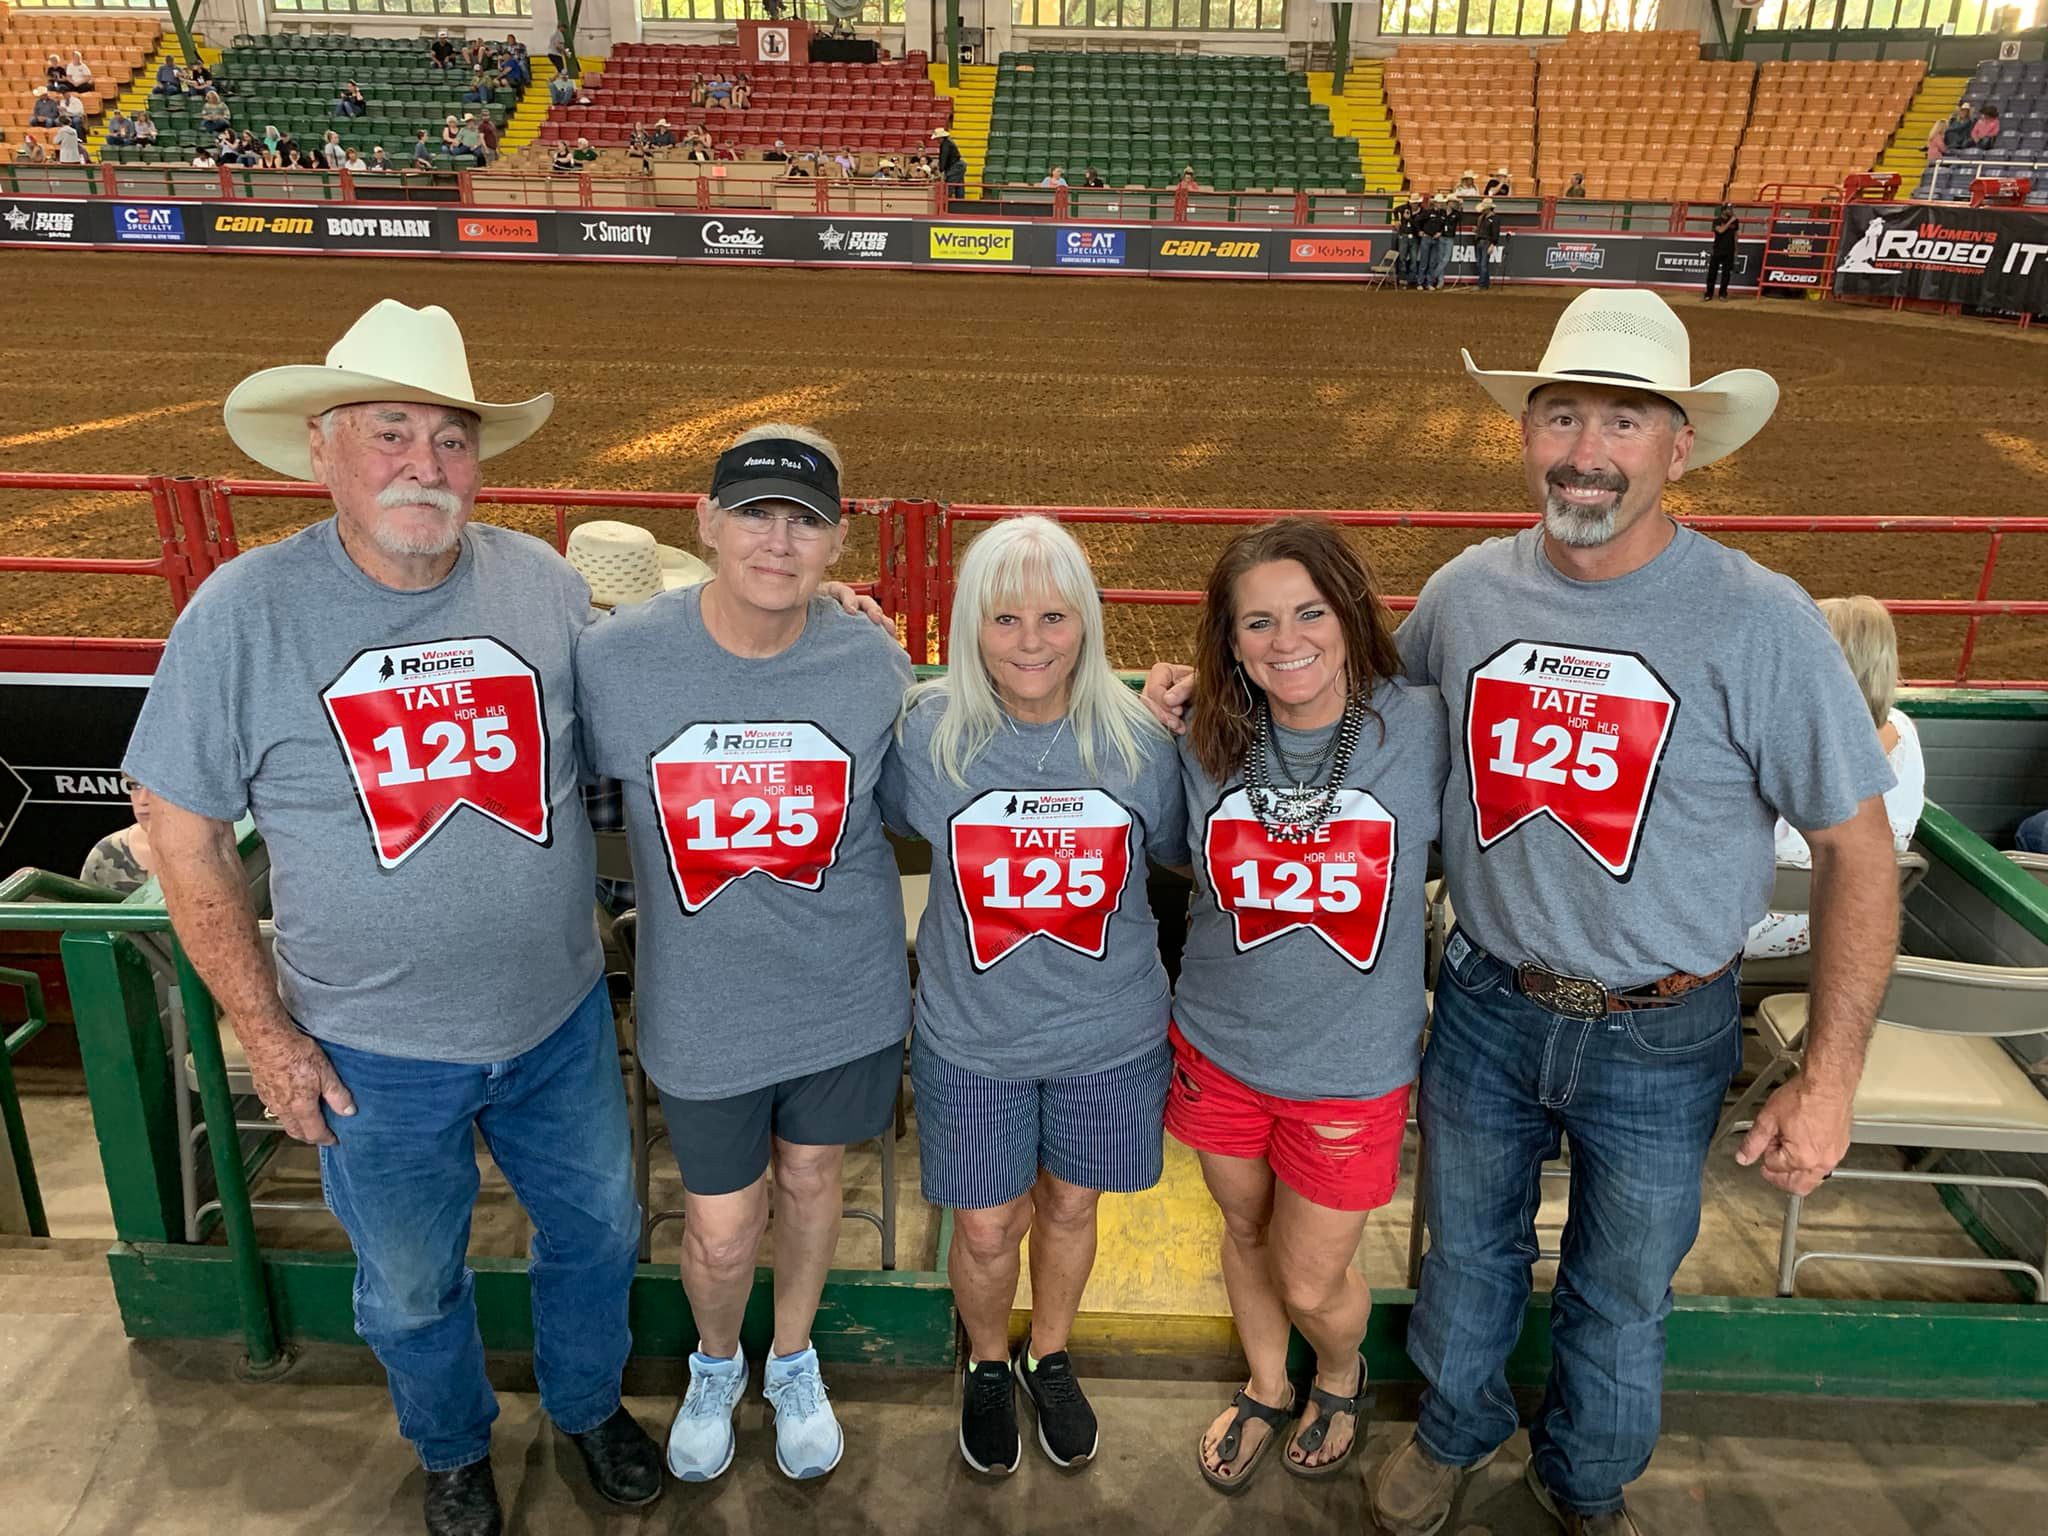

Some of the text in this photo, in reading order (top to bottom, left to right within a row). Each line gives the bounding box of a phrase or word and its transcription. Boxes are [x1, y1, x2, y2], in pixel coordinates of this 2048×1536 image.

[37, 212, 75, 223] RIDE
[124, 208, 171, 225] CEAT
[214, 216, 314, 234] can-am
[35, 222, 73, 231] PASS
[127, 223, 172, 231] SPECIALTY
[327, 218, 431, 237] BOOT BARN
[486, 225, 532, 237] Kubota
[600, 221, 651, 245] Smarty
[1920, 223, 1998, 243] WOMEN'S
[848, 240, 886, 250] PASS
[851, 231, 889, 242] RIDE
[934, 232, 1011, 255] Wrangler
[1067, 232, 1115, 248] CEAT
[1068, 247, 1114, 255] SPECIALTY
[1161, 240, 1260, 257] can-am
[1318, 246, 1364, 257] Kubota
[1451, 245, 1504, 263] BAN
[1877, 229, 1994, 264] RODEO
[1550, 251, 1600, 264] CHALLENGER
[1664, 258, 1706, 266] WESTERN
[2002, 242, 2048, 275] IT
[1875, 261, 1985, 275] WORLD CHAMPIONSHIP
[1769, 271, 1817, 283] RODEO
[401, 657, 474, 675] RODEO
[1540, 657, 1610, 680] RODEO
[397, 682, 474, 711] TATE
[1529, 686, 1598, 718] TATE
[454, 705, 506, 721] HDR HLR
[1568, 716, 1619, 735] HDR HLR
[724, 735, 792, 749] RODEO
[372, 715, 517, 787] 125
[1489, 717, 1619, 792] 125
[715, 763, 785, 784] TATE
[764, 785, 813, 795] HDR HLR
[1022, 800, 1083, 814] RODEO
[686, 796, 819, 850] 125
[1010, 829, 1076, 848] TATE
[1054, 849, 1102, 858] HDR HLR
[1304, 852, 1356, 862] HDR HLR
[982, 857, 1106, 908] 125
[1232, 860, 1361, 913] 125
